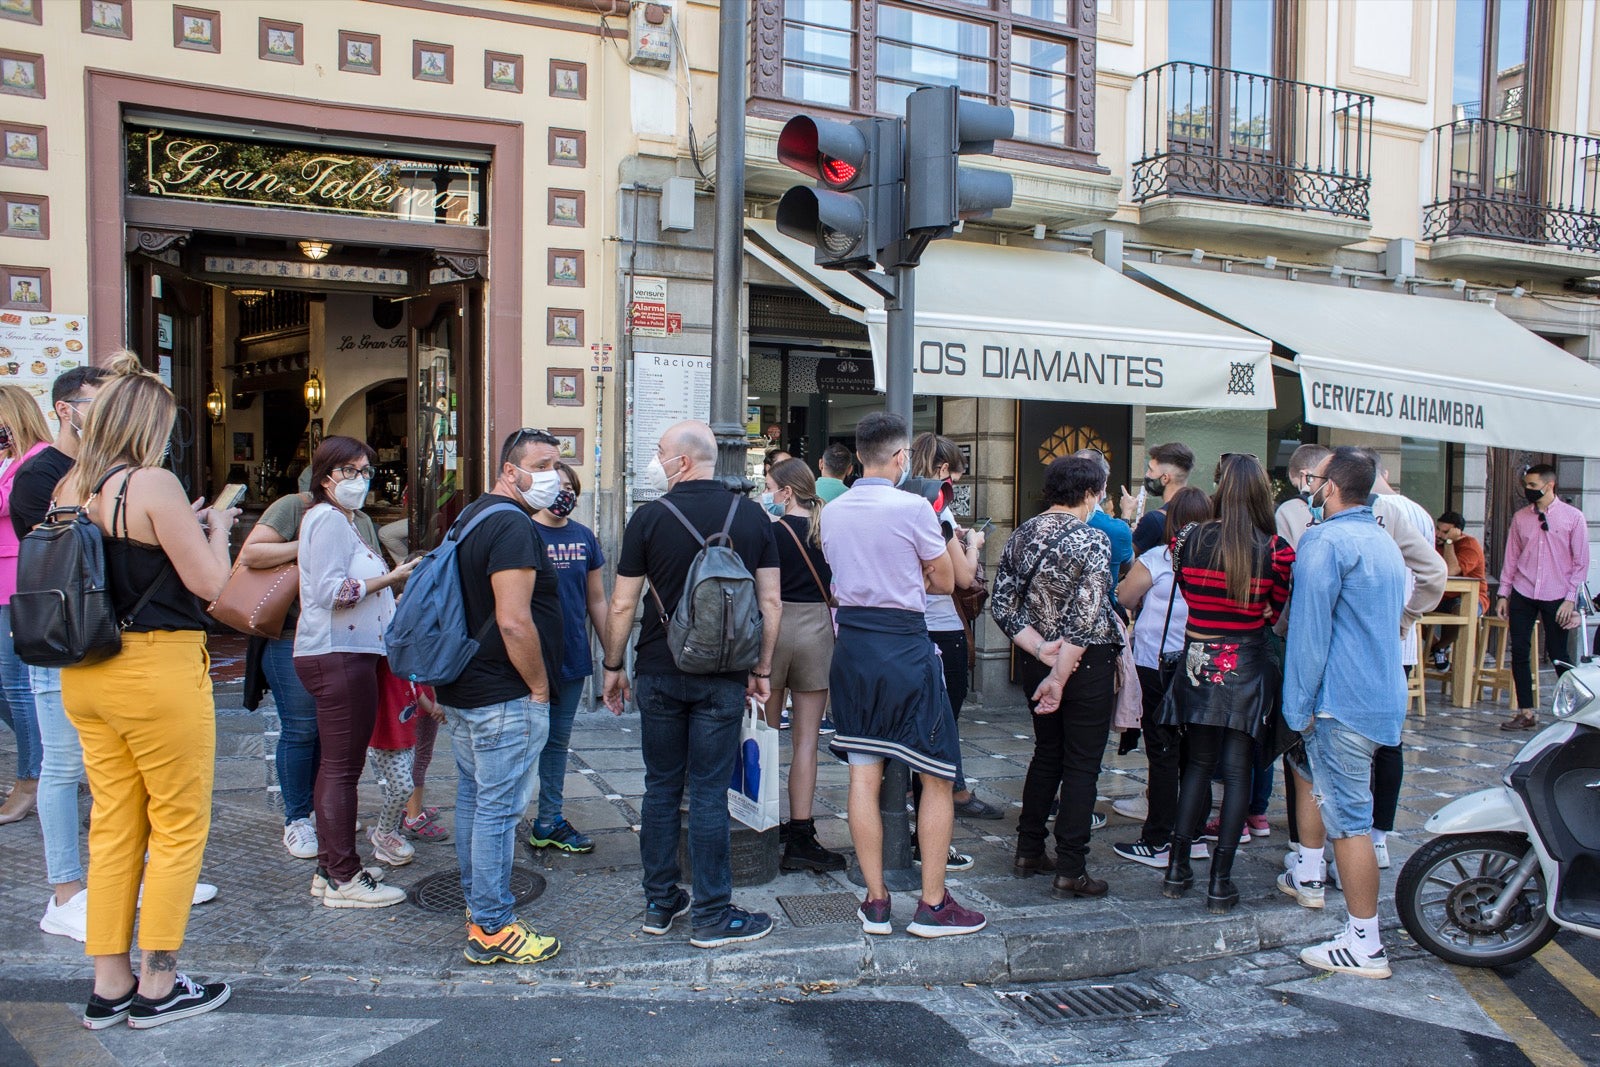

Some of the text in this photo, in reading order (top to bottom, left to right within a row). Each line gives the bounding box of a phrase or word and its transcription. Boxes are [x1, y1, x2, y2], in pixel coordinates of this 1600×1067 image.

[163, 140, 460, 209] Gran Taberna
[634, 303, 665, 312] Alarma
[358, 334, 387, 349] Gran
[913, 341, 1164, 388] OS DIAMANTES
[1312, 381, 1485, 430] CERVEZAS ALHAMBRA
